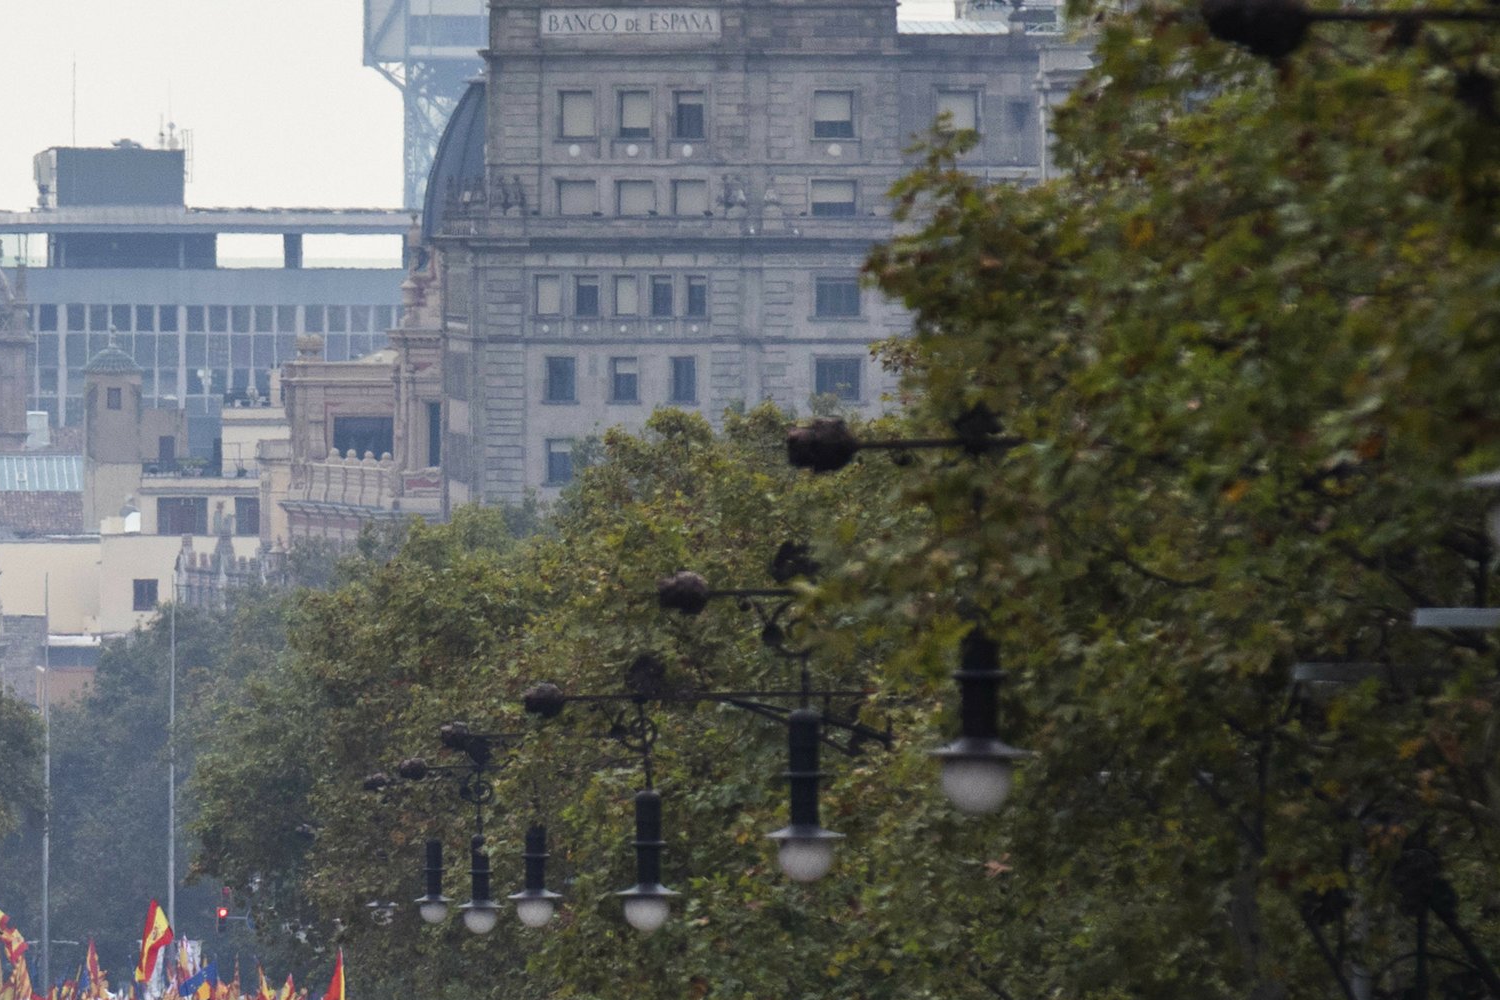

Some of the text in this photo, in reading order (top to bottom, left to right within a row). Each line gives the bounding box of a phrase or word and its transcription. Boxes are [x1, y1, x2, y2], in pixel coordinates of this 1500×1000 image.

[548, 12, 714, 31] BANCO DE ESPAÑA
